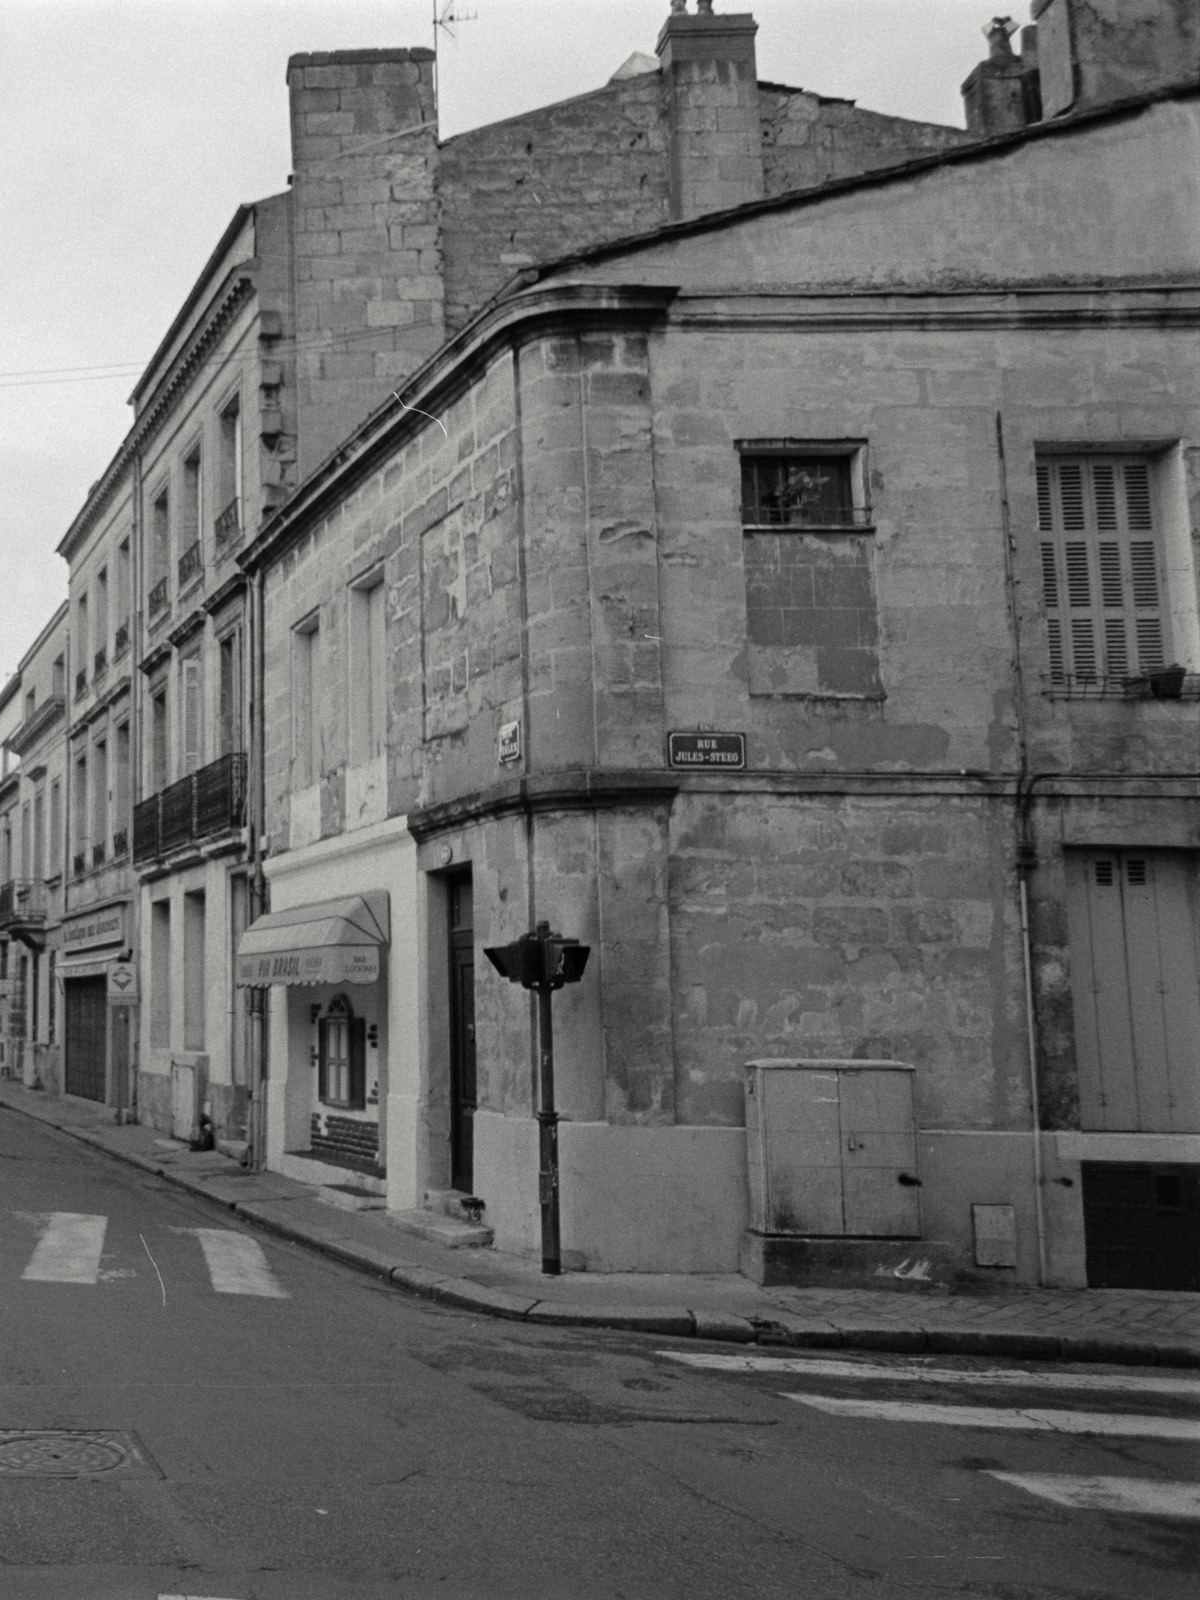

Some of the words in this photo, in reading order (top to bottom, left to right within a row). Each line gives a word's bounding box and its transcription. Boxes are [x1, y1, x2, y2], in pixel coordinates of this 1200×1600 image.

[697, 738, 718, 749] RUE
[675, 751, 739, 763] JULES-STEEG
[272, 956, 300, 978] BRASIL
